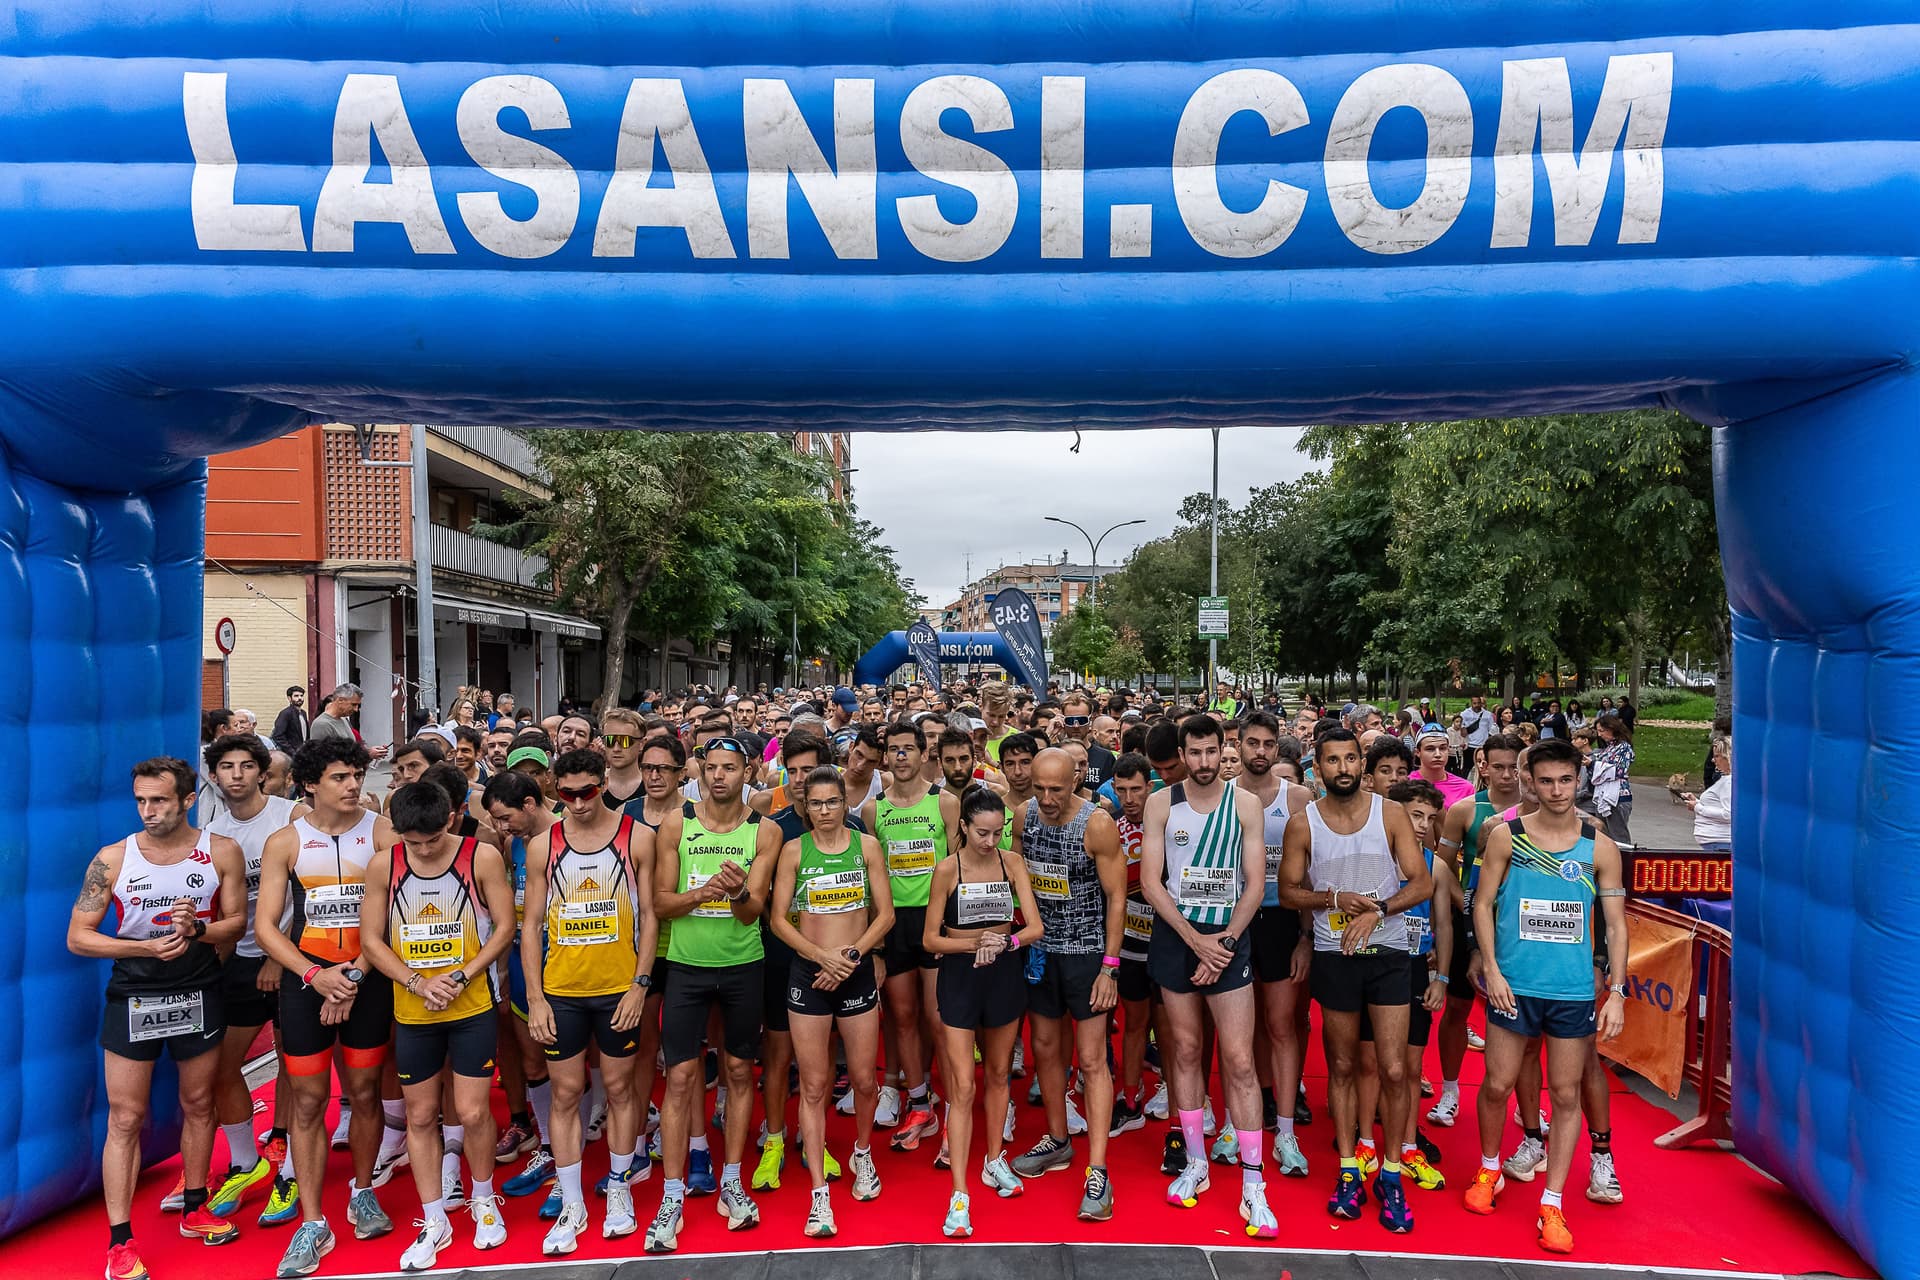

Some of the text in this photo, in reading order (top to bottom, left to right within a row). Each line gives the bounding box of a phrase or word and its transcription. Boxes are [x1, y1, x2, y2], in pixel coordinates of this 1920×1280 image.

[183, 51, 1674, 263] LASANSI.COM
[908, 644, 993, 657] LNSI.COM
[884, 816, 930, 827] LASANSI.COM
[908, 840, 933, 850] LASANSI
[688, 846, 744, 856] LASANSI.COM
[801, 867, 824, 875] LEA
[1043, 864, 1067, 875] LASANSI
[1208, 869, 1233, 879] LASANSI
[835, 872, 862, 885] LASANSI
[1031, 877, 1063, 889] JORDI
[986, 883, 1009, 894] LASANSI
[815, 891, 858, 901] BARBARA
[585, 901, 616, 914] LASANSI
[1551, 902, 1582, 913] LASANSI
[429, 923, 461, 935] LASANSI
[565, 920, 609, 931] DANIEL
[1528, 919, 1576, 929] GERARD
[410, 942, 453, 954] HUGO
[141, 1008, 192, 1026] ALEX
